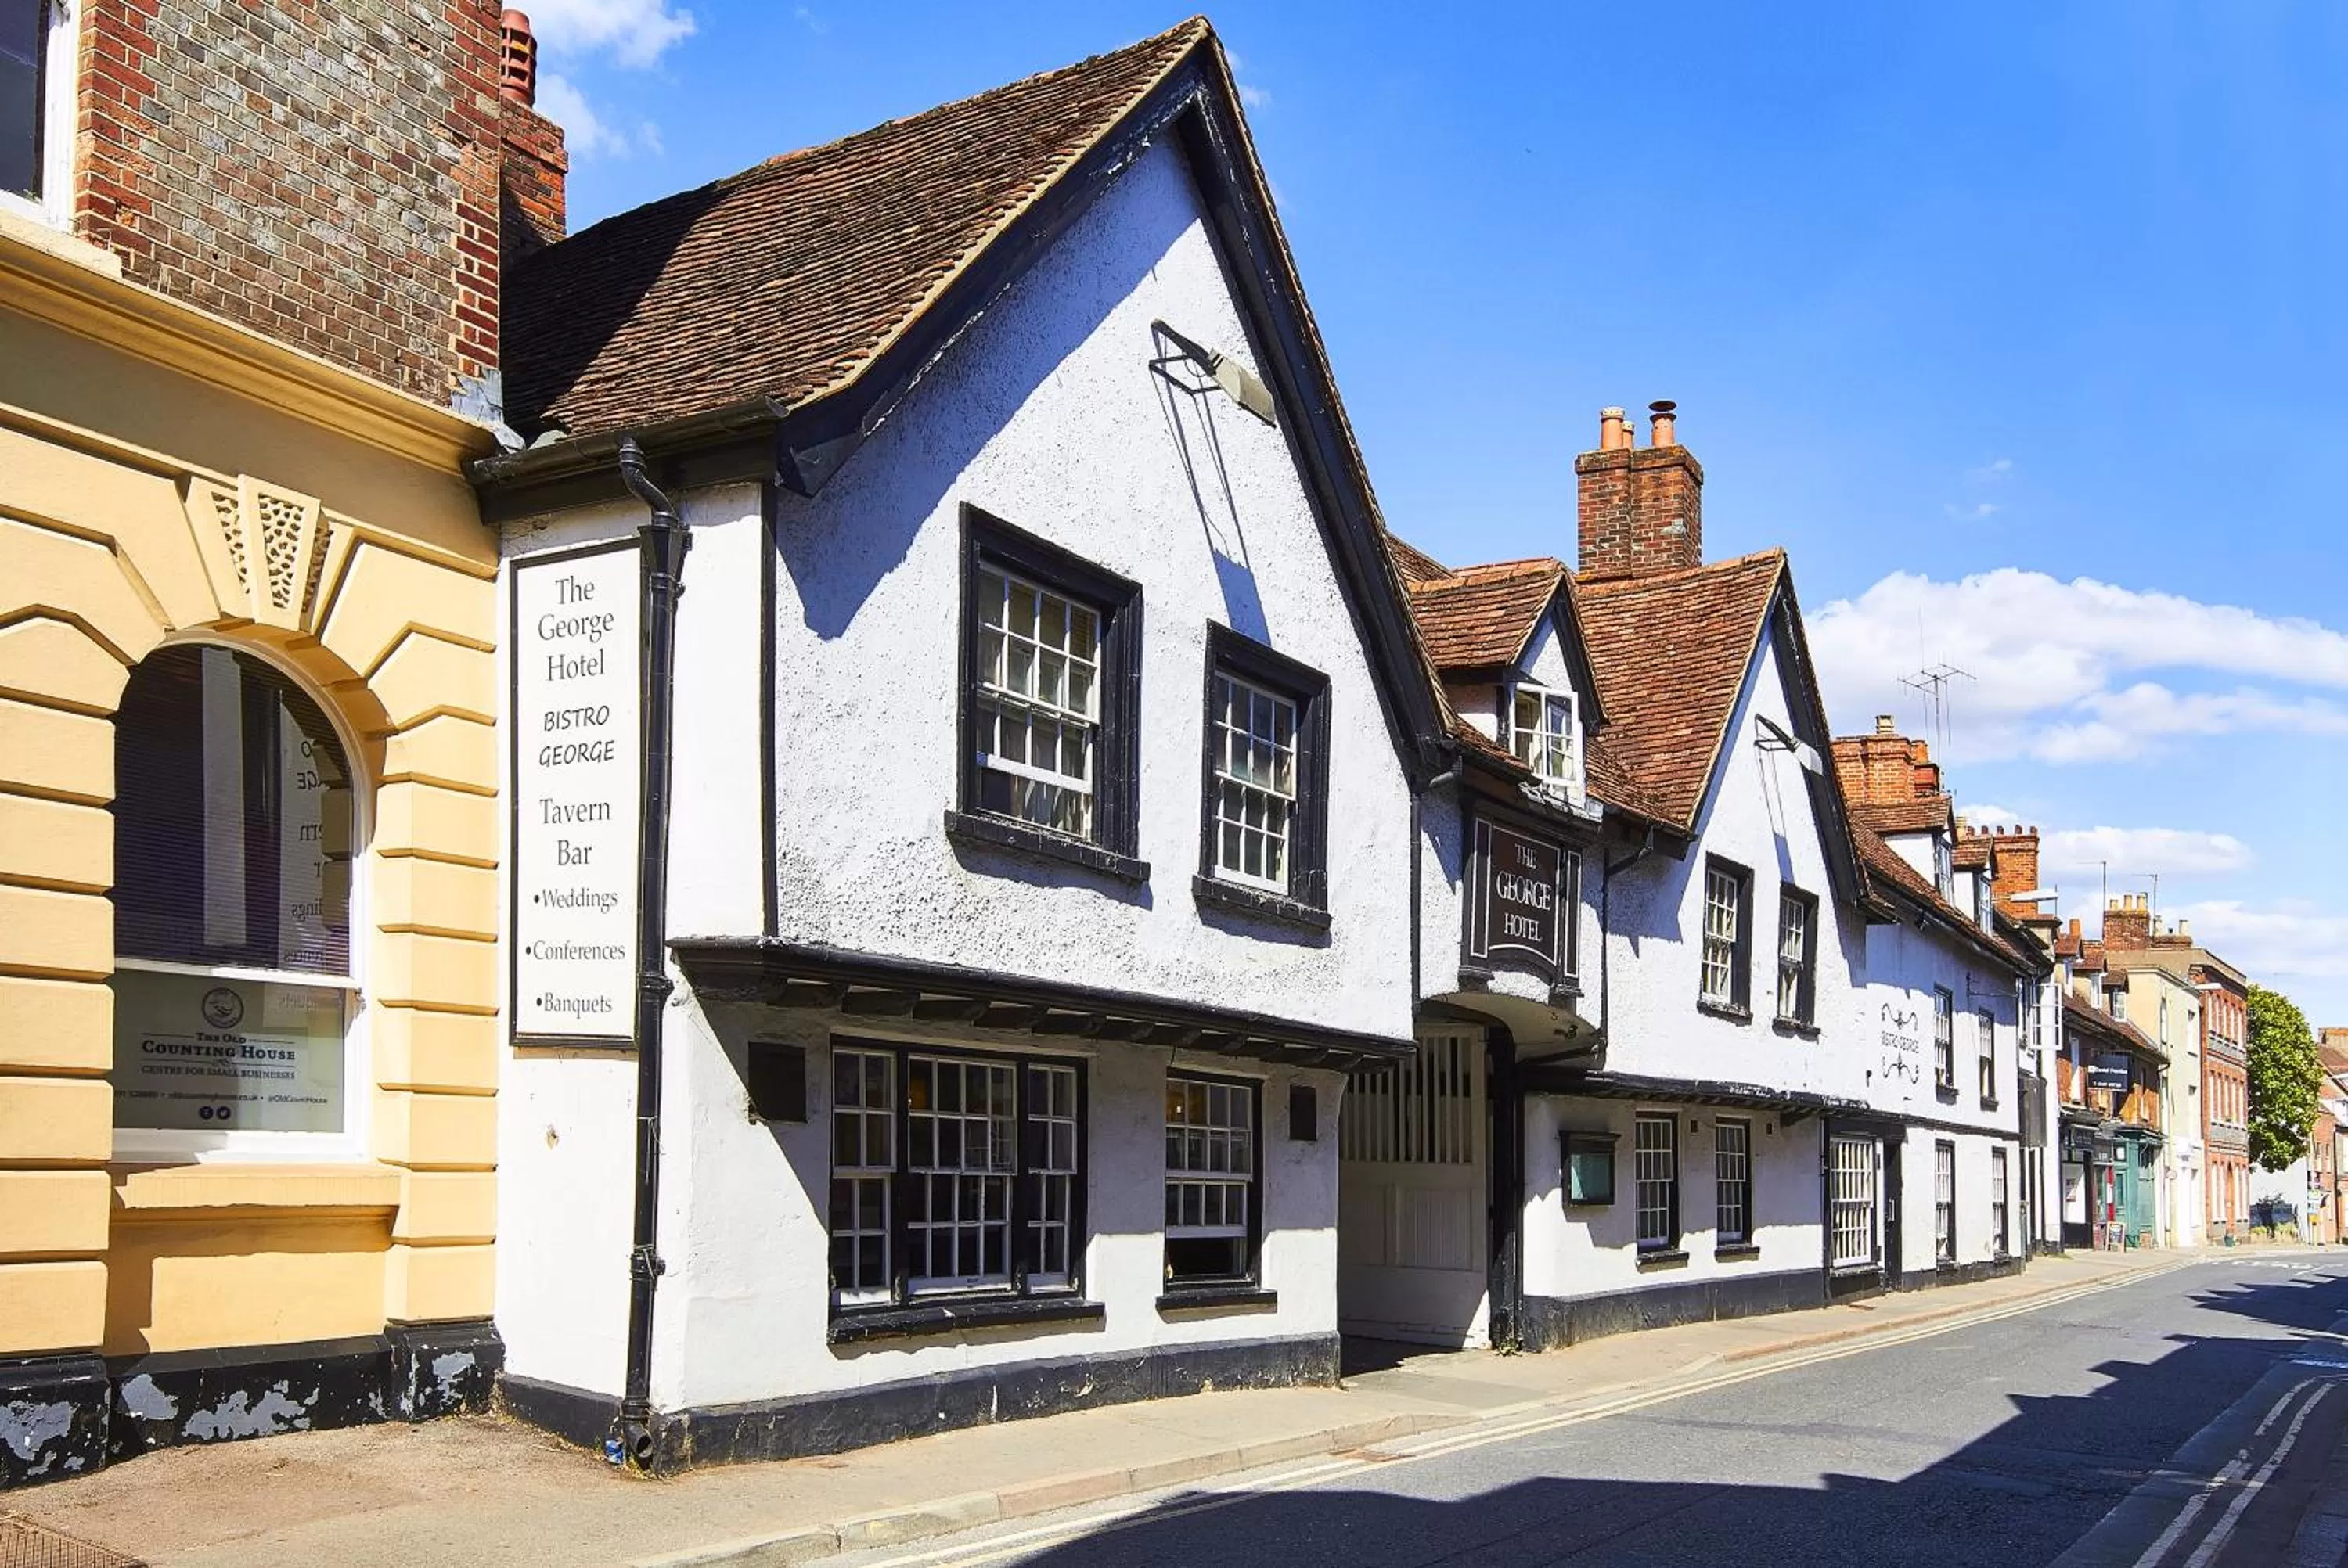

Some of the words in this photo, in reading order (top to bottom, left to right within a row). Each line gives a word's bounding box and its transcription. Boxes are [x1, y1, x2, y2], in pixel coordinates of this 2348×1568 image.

[554, 575, 595, 605] The
[538, 612, 614, 643] George
[547, 648, 604, 682] Hotel
[544, 705, 610, 732] BISTRO
[538, 740, 614, 768] GEORGE
[539, 797, 611, 824] Tavern
[556, 840, 592, 865] Bar
[1514, 843, 1536, 869] THE
[542, 888, 618, 914] Weddings
[1496, 870, 1552, 911] GEORGE
[1504, 913, 1541, 941] HOTEL
[533, 940, 625, 961] Conferences
[544, 991, 613, 1019] Banquets
[240, 1045, 295, 1060] HOUSE
